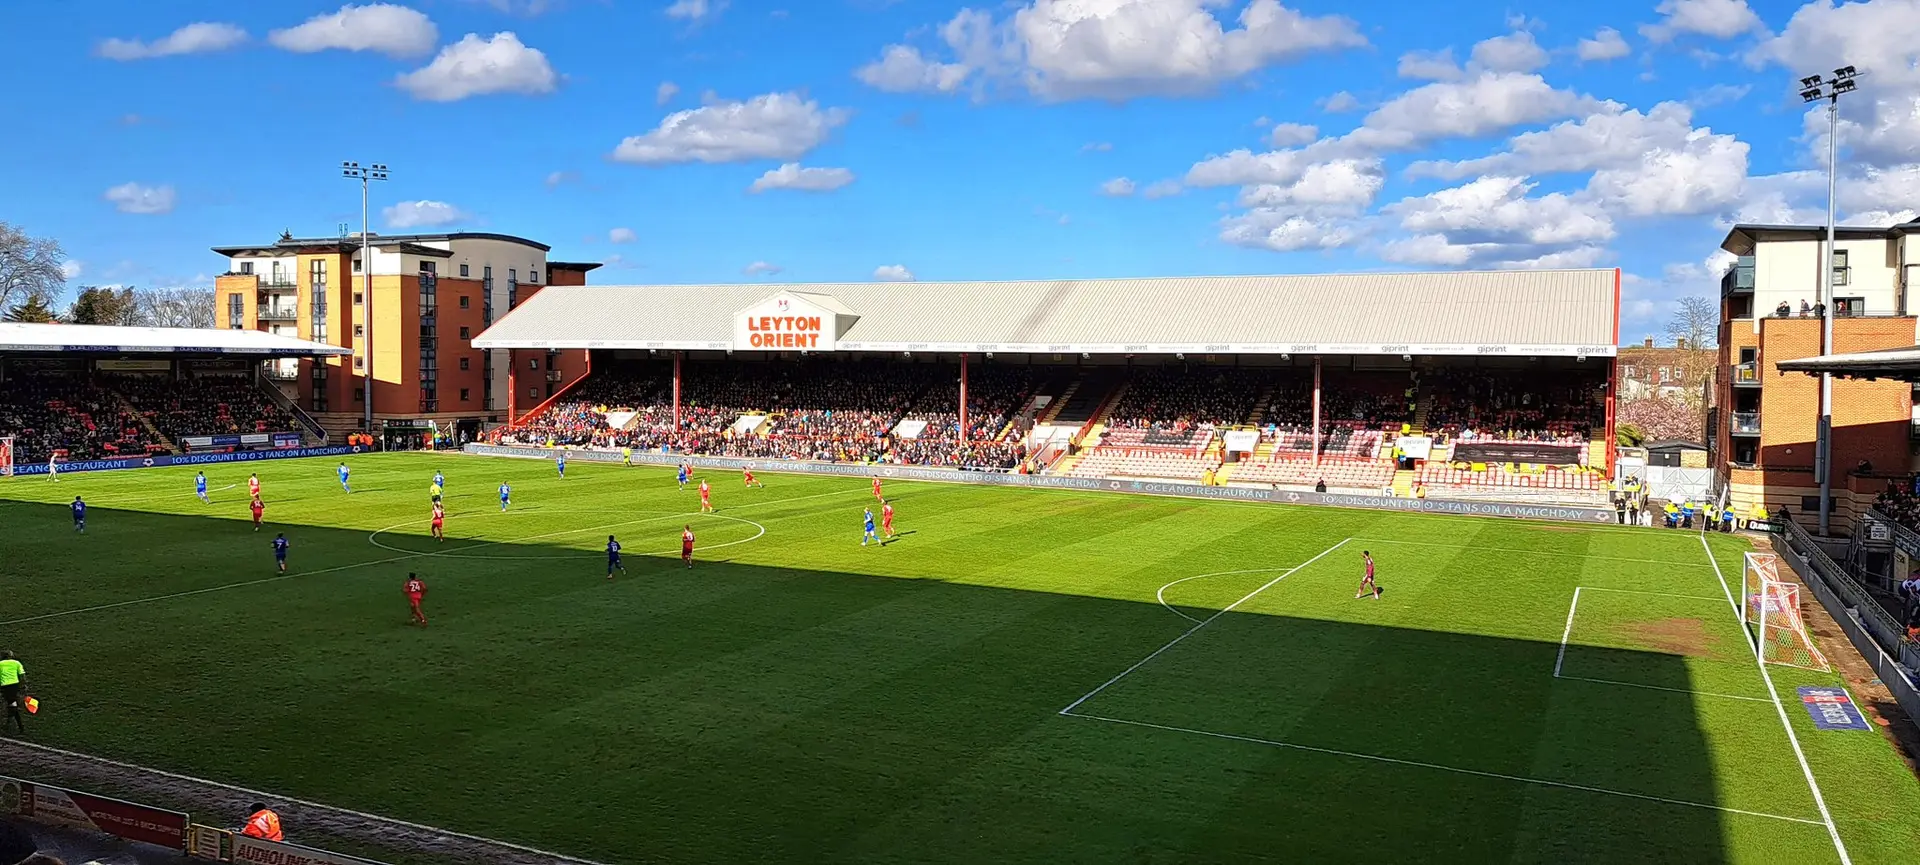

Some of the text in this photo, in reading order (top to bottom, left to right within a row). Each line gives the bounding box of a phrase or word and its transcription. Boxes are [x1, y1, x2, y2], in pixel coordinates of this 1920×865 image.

[748, 316, 821, 331] LEYTON
[749, 332, 819, 347] ORIENT
[1124, 344, 1148, 352] giprint
[1205, 344, 1230, 352] giprint
[1290, 344, 1317, 353] giprint
[1381, 345, 1409, 353] giprint
[1477, 345, 1507, 354] giprint
[1576, 346, 1608, 355] giprint
[171, 456, 190, 465] 10%
[191, 453, 235, 464] DISCOUNT
[236, 452, 248, 461] TO
[265, 450, 286, 459] FANS
[286, 449, 299, 457] ON
[300, 448, 307, 456] A
[307, 446, 348, 455] MATCHDAY
[56, 460, 128, 472] RESTAURANT
[701, 458, 742, 468] MATCHDAY
[775, 462, 870, 475] OCEANO RESTAURANT
[926, 470, 970, 480] DISCOUNT
[1002, 475, 1025, 484] FANS
[1027, 476, 1041, 485] ON
[1042, 477, 1050, 486] A
[1051, 477, 1102, 488] MATCHDAY
[1145, 483, 1270, 499] OCEANO RESTAURANT
[1385, 488, 1393, 497] 5
[1321, 495, 1344, 504] 10%
[1346, 496, 1405, 508] DISCOUNT
[1406, 499, 1420, 509] TO
[1448, 502, 1479, 512] FANS
[1481, 504, 1500, 514] ON
[1503, 505, 1512, 515] A
[1514, 506, 1584, 519] MATCHDAY
[409, 581, 420, 592] 24
